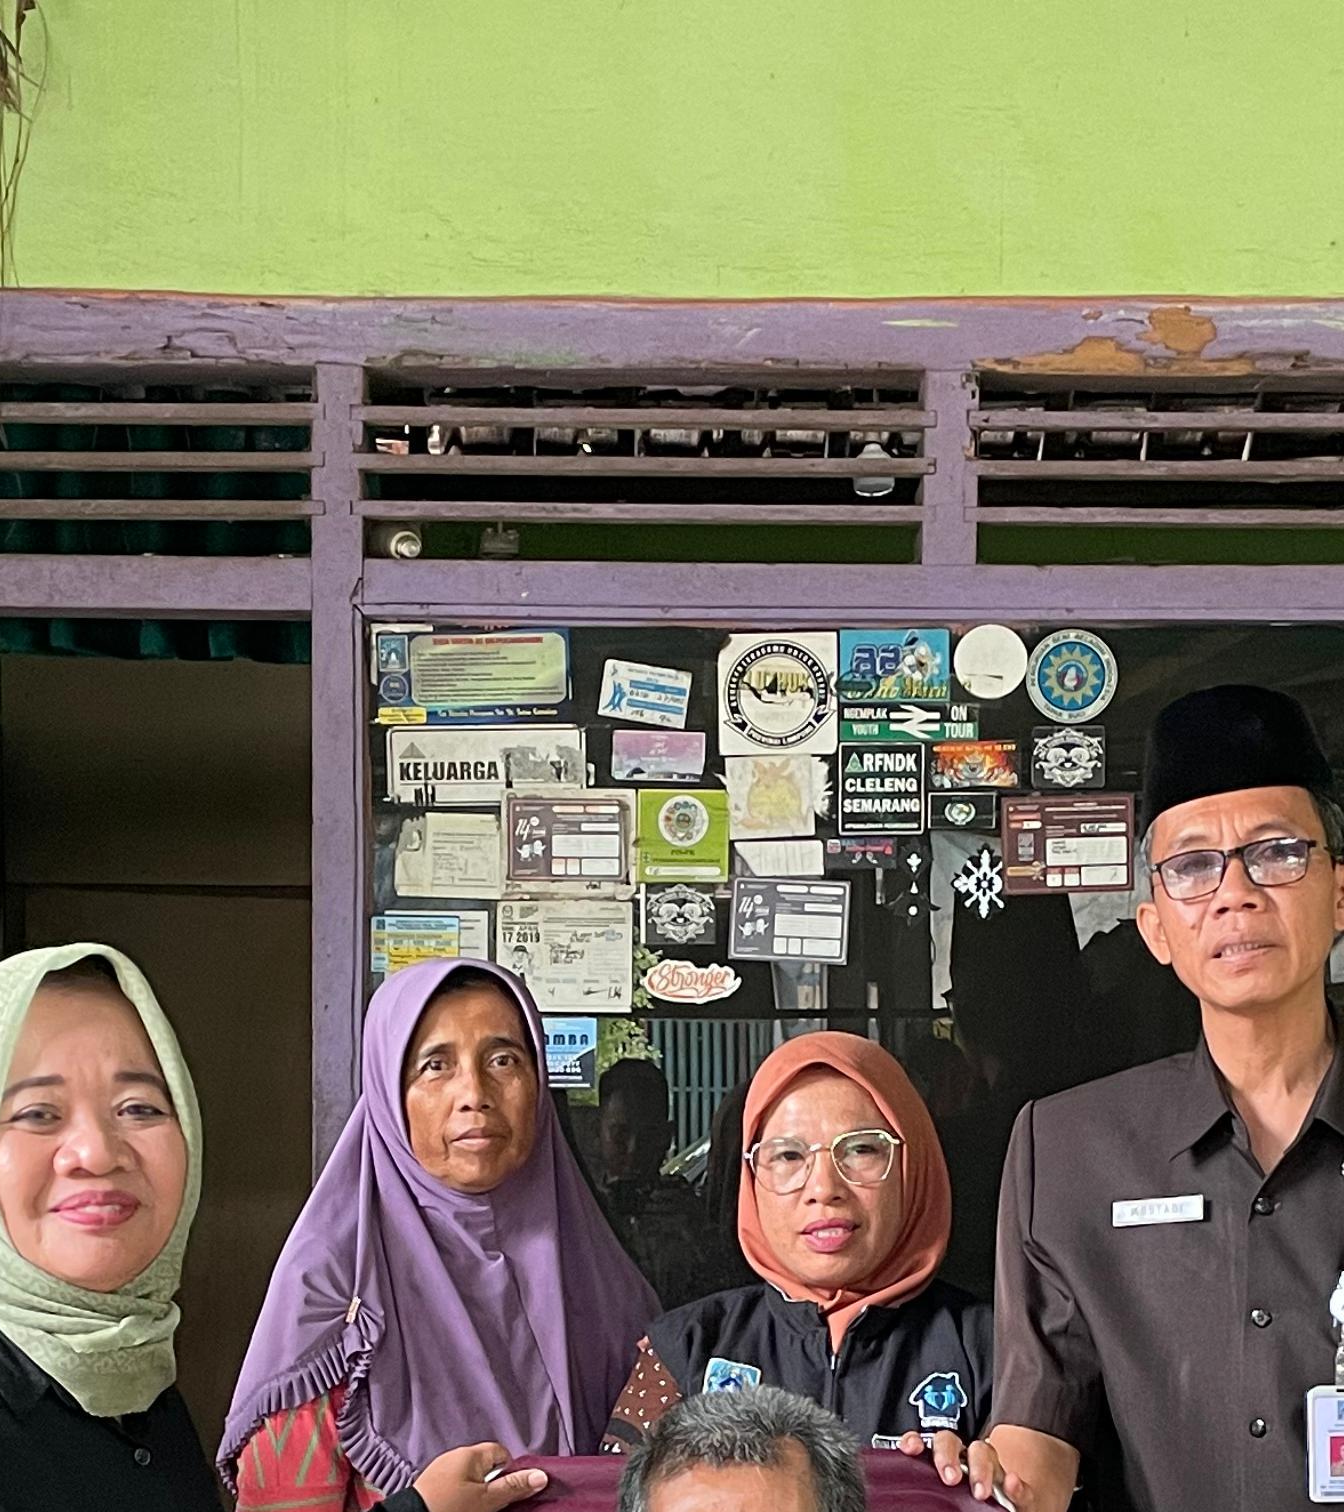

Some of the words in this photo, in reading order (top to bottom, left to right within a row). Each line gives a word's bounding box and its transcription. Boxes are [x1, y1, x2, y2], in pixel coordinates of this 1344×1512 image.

[950, 704, 969, 721] ON
[852, 723, 880, 736] YOUTH
[943, 722, 975, 739] TOUR
[398, 760, 500, 782] KELUARGA
[842, 797, 921, 814] SEMARANG
[502, 931, 513, 943] 17
[516, 931, 540, 943] 2019
